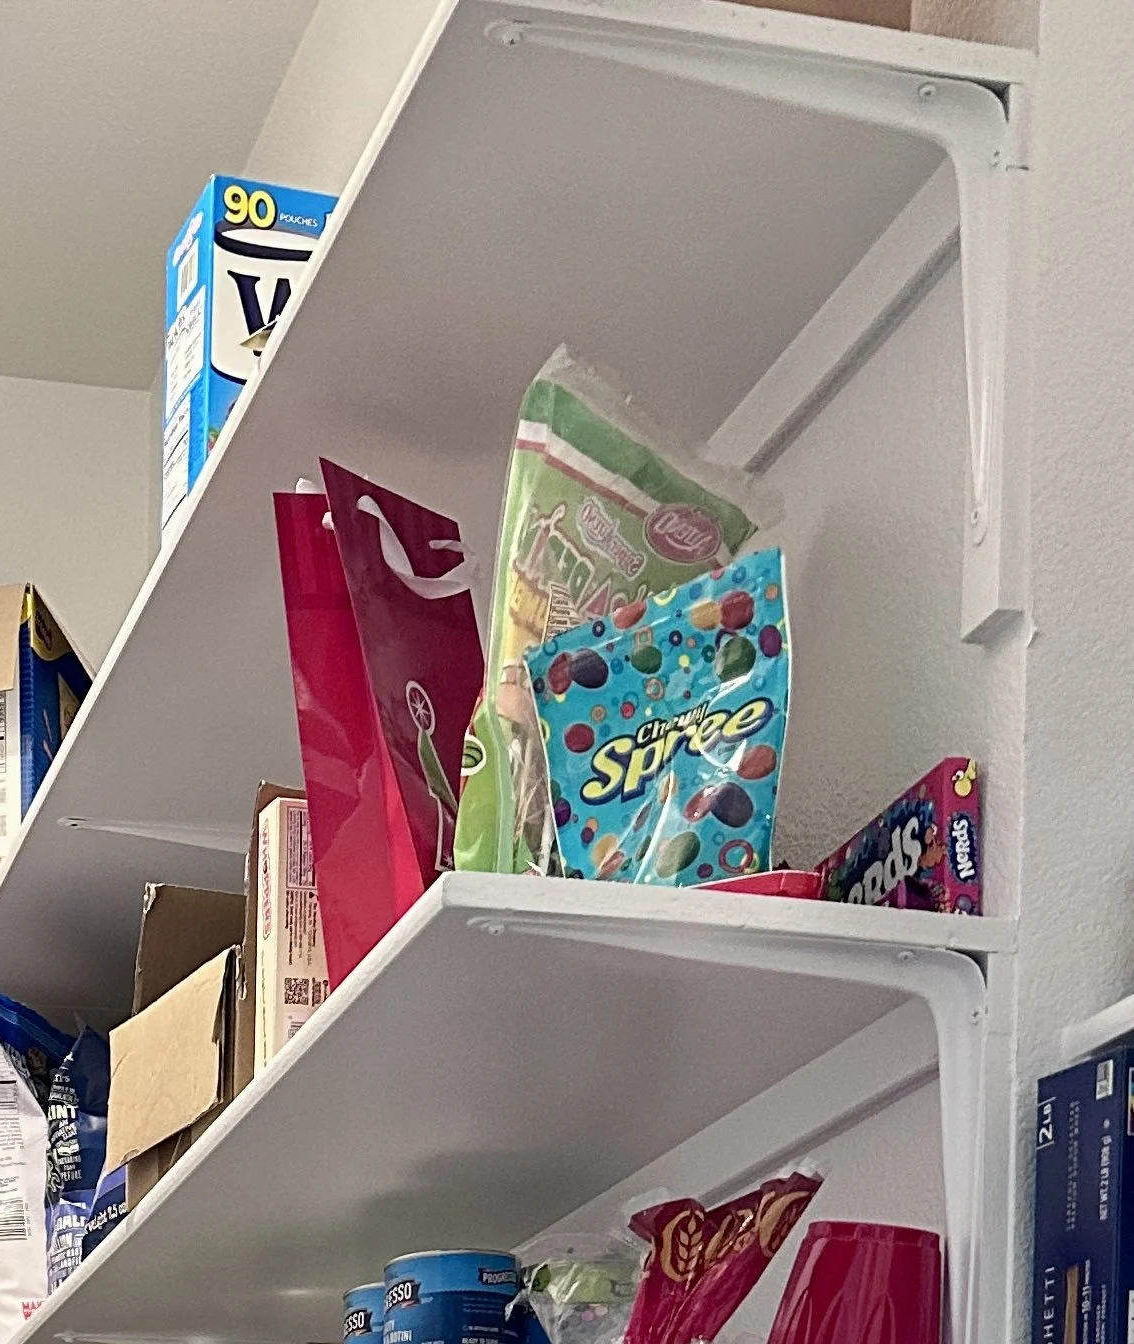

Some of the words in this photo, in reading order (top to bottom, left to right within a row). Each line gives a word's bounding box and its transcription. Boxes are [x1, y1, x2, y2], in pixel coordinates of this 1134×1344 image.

[224, 185, 277, 228] 90
[280, 212, 318, 227] POUCHES
[636, 700, 707, 744] Chewy
[580, 698, 773, 806] Spree
